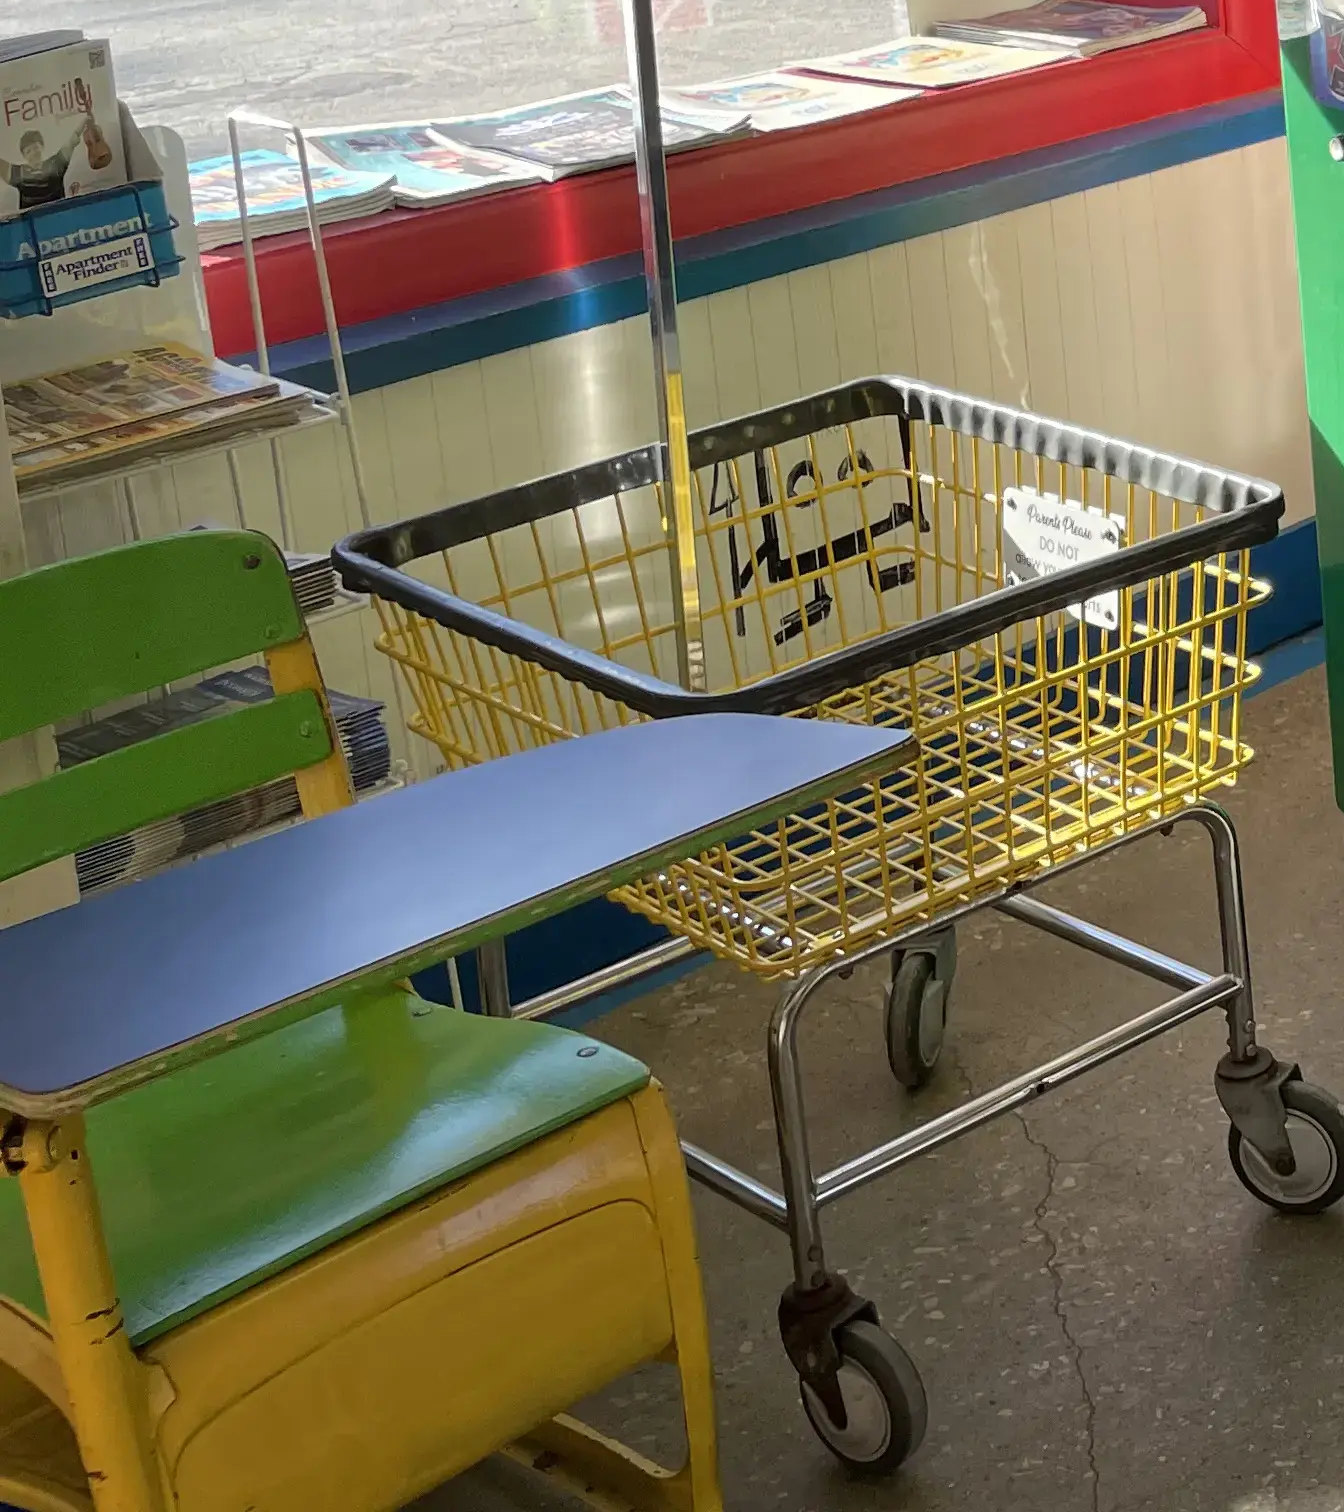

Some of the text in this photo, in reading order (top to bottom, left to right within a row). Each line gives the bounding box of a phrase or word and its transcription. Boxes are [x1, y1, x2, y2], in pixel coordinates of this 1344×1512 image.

[4, 82, 93, 127] Family
[56, 246, 134, 275] Apartment
[73, 262, 120, 281] Finder
[1026, 503, 1093, 540] Parents Please
[1039, 535, 1080, 562] DO NOT
